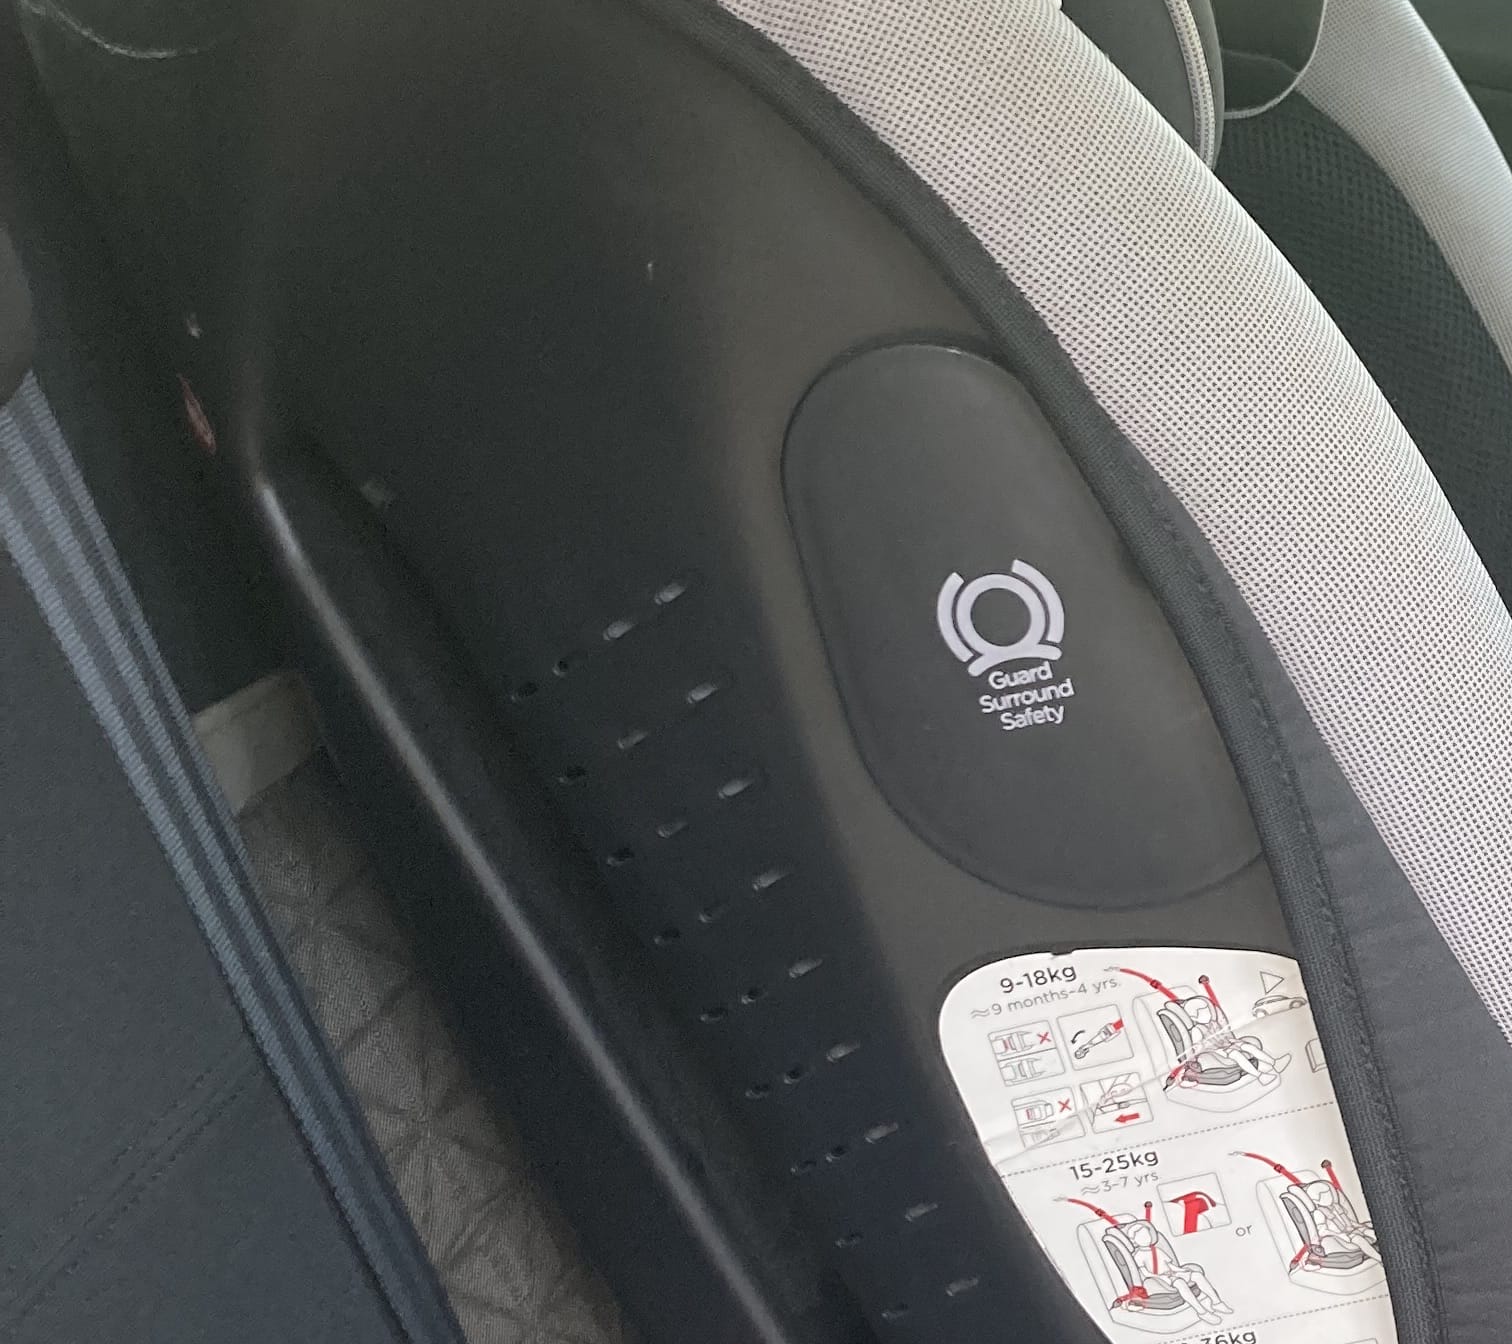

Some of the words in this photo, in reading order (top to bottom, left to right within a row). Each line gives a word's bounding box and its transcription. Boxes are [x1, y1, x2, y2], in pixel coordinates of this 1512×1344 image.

[989, 661, 1052, 689] Guard
[979, 678, 1074, 713] Surround
[1000, 705, 1064, 730] Safety
[1000, 966, 1077, 993] 9-18kg
[1070, 1152, 1158, 1180] 15-25kg
[1235, 1225, 1252, 1236] or
